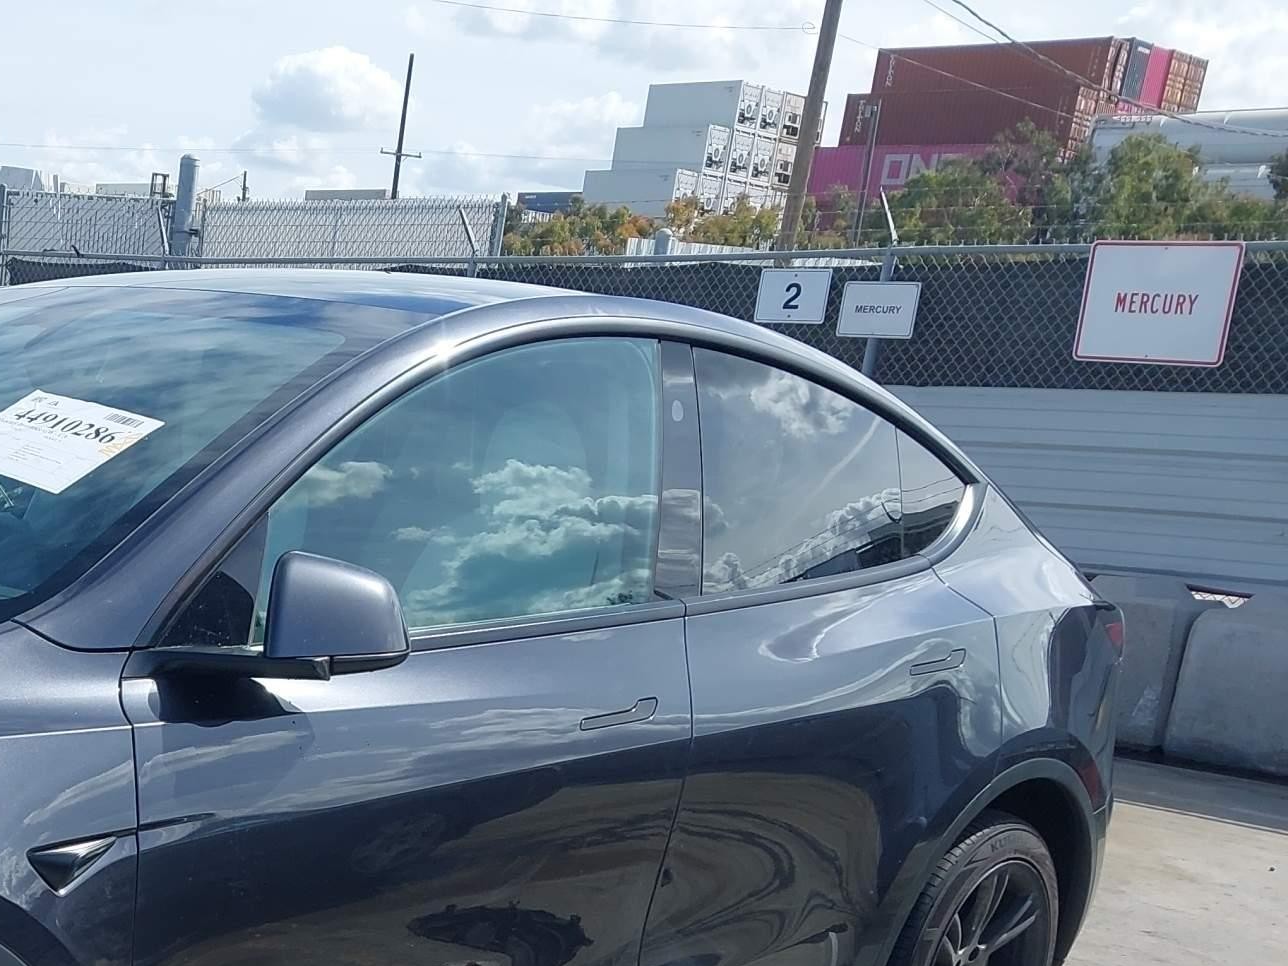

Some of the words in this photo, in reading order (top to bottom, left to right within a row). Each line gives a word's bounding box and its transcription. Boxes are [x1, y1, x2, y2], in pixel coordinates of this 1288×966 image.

[782, 283, 802, 310] 2
[855, 304, 902, 314] MERCURY
[1114, 292, 1199, 315] MERCURY
[15, 409, 125, 444] 44910286
